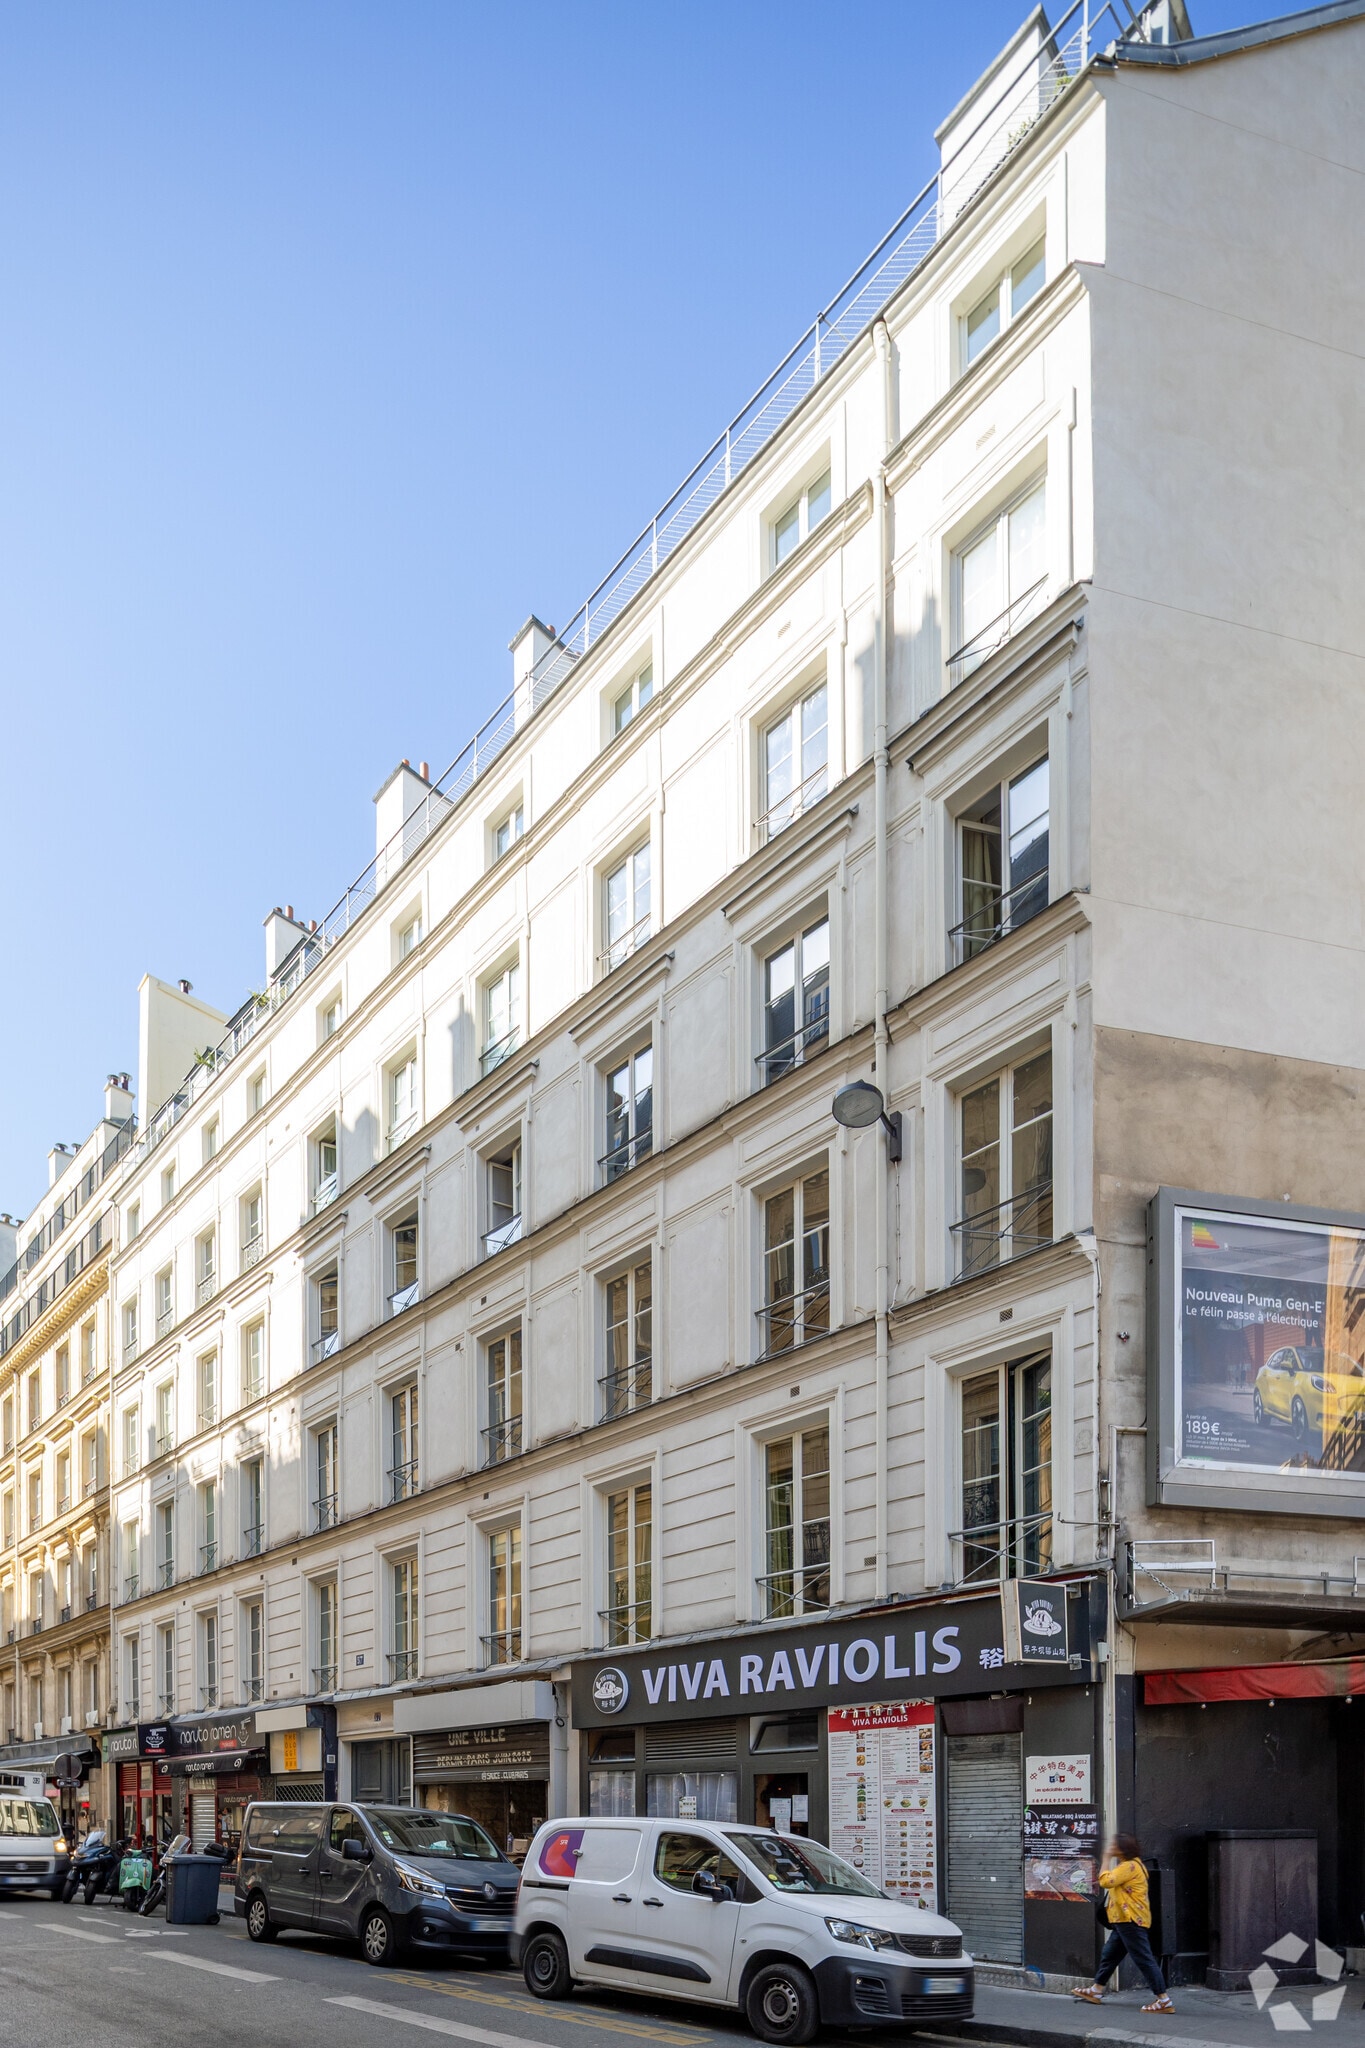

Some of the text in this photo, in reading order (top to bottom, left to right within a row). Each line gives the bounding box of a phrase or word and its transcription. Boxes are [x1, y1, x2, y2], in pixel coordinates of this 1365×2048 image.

[1186, 1287, 1243, 1304] Nouveau
[1247, 1293, 1282, 1308] Puma
[1185, 1305, 1197, 1316] Le
[1200, 1306, 1224, 1318] félin
[1226, 1310, 1255, 1321] passe
[1257, 1311, 1264, 1321] à
[1186, 1420, 1220, 1435] 189€
[641, 1626, 962, 1705] VIVA RAVIOLIS
[852, 1714, 908, 1727] VIVA RAVIOLIS
[110, 1735, 132, 1752] naruto
[180, 1726, 208, 1745] naruto
[211, 1725, 237, 1740] ramen
[448, 1728, 506, 1746] UNE VILLE
[185, 1762, 214, 1772] naruto ramen
